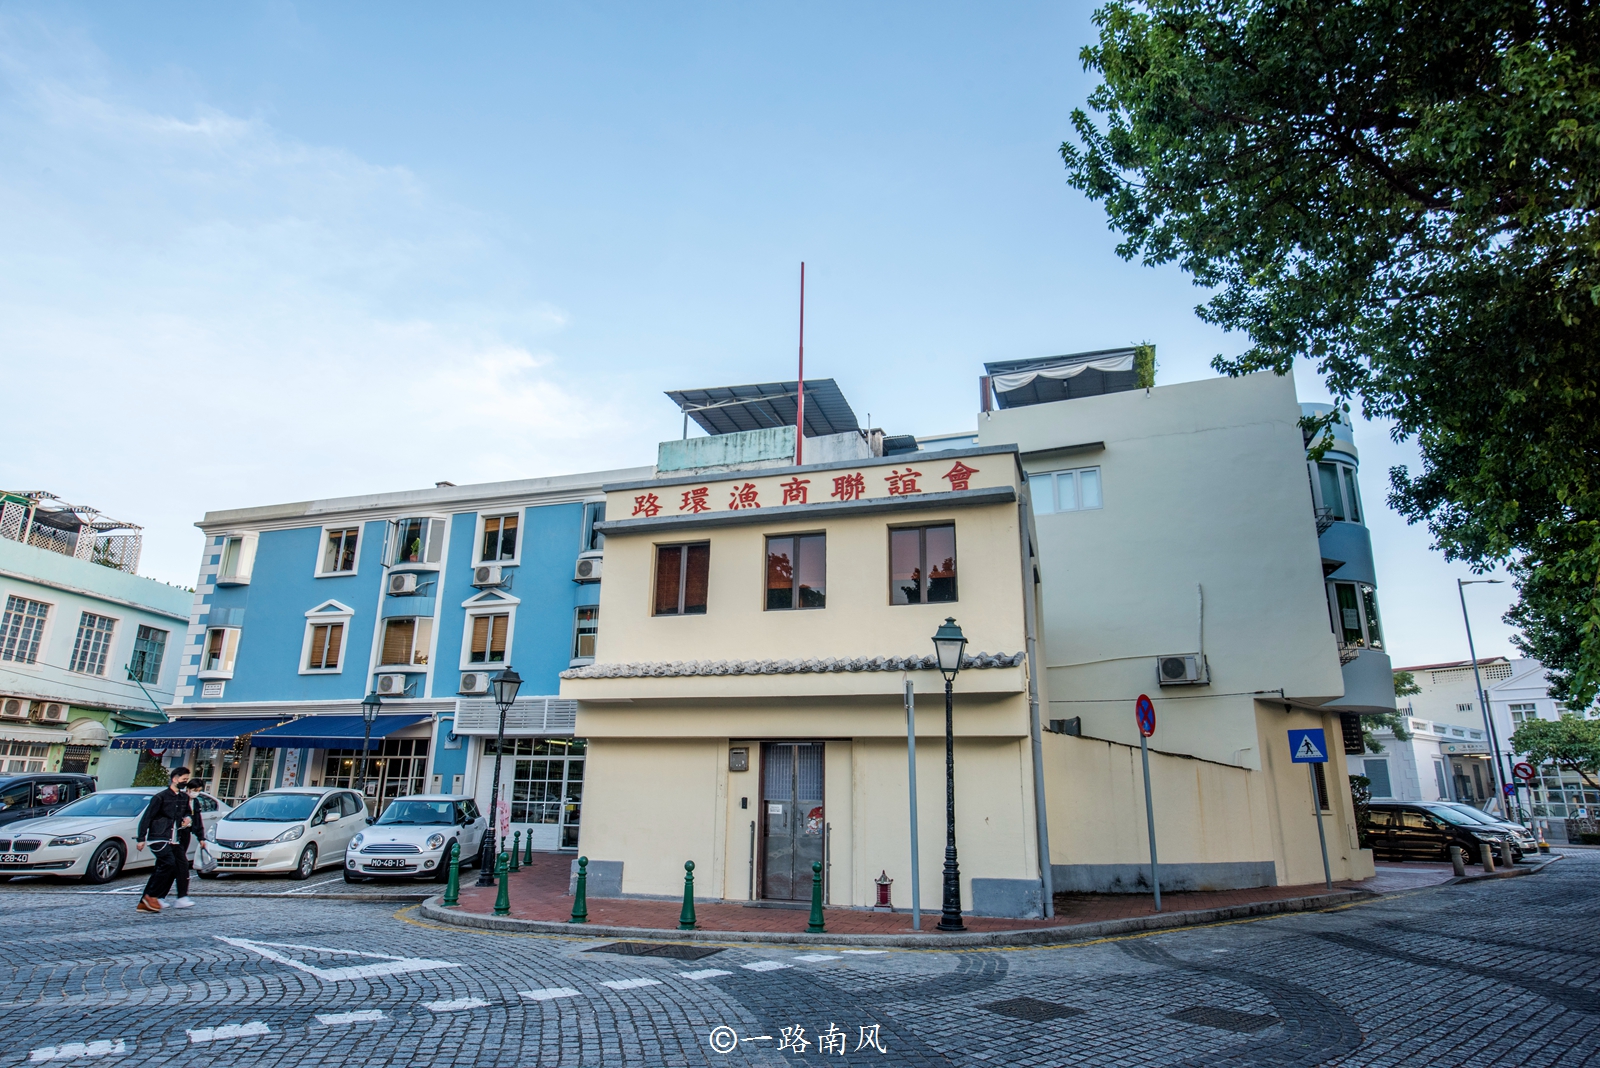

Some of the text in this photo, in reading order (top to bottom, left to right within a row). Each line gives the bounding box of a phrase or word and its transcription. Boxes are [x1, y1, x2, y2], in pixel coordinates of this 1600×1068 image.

[631, 460, 980, 518] 路環漁商聯誼會
[371, 859, 405, 867] MO-48-13
